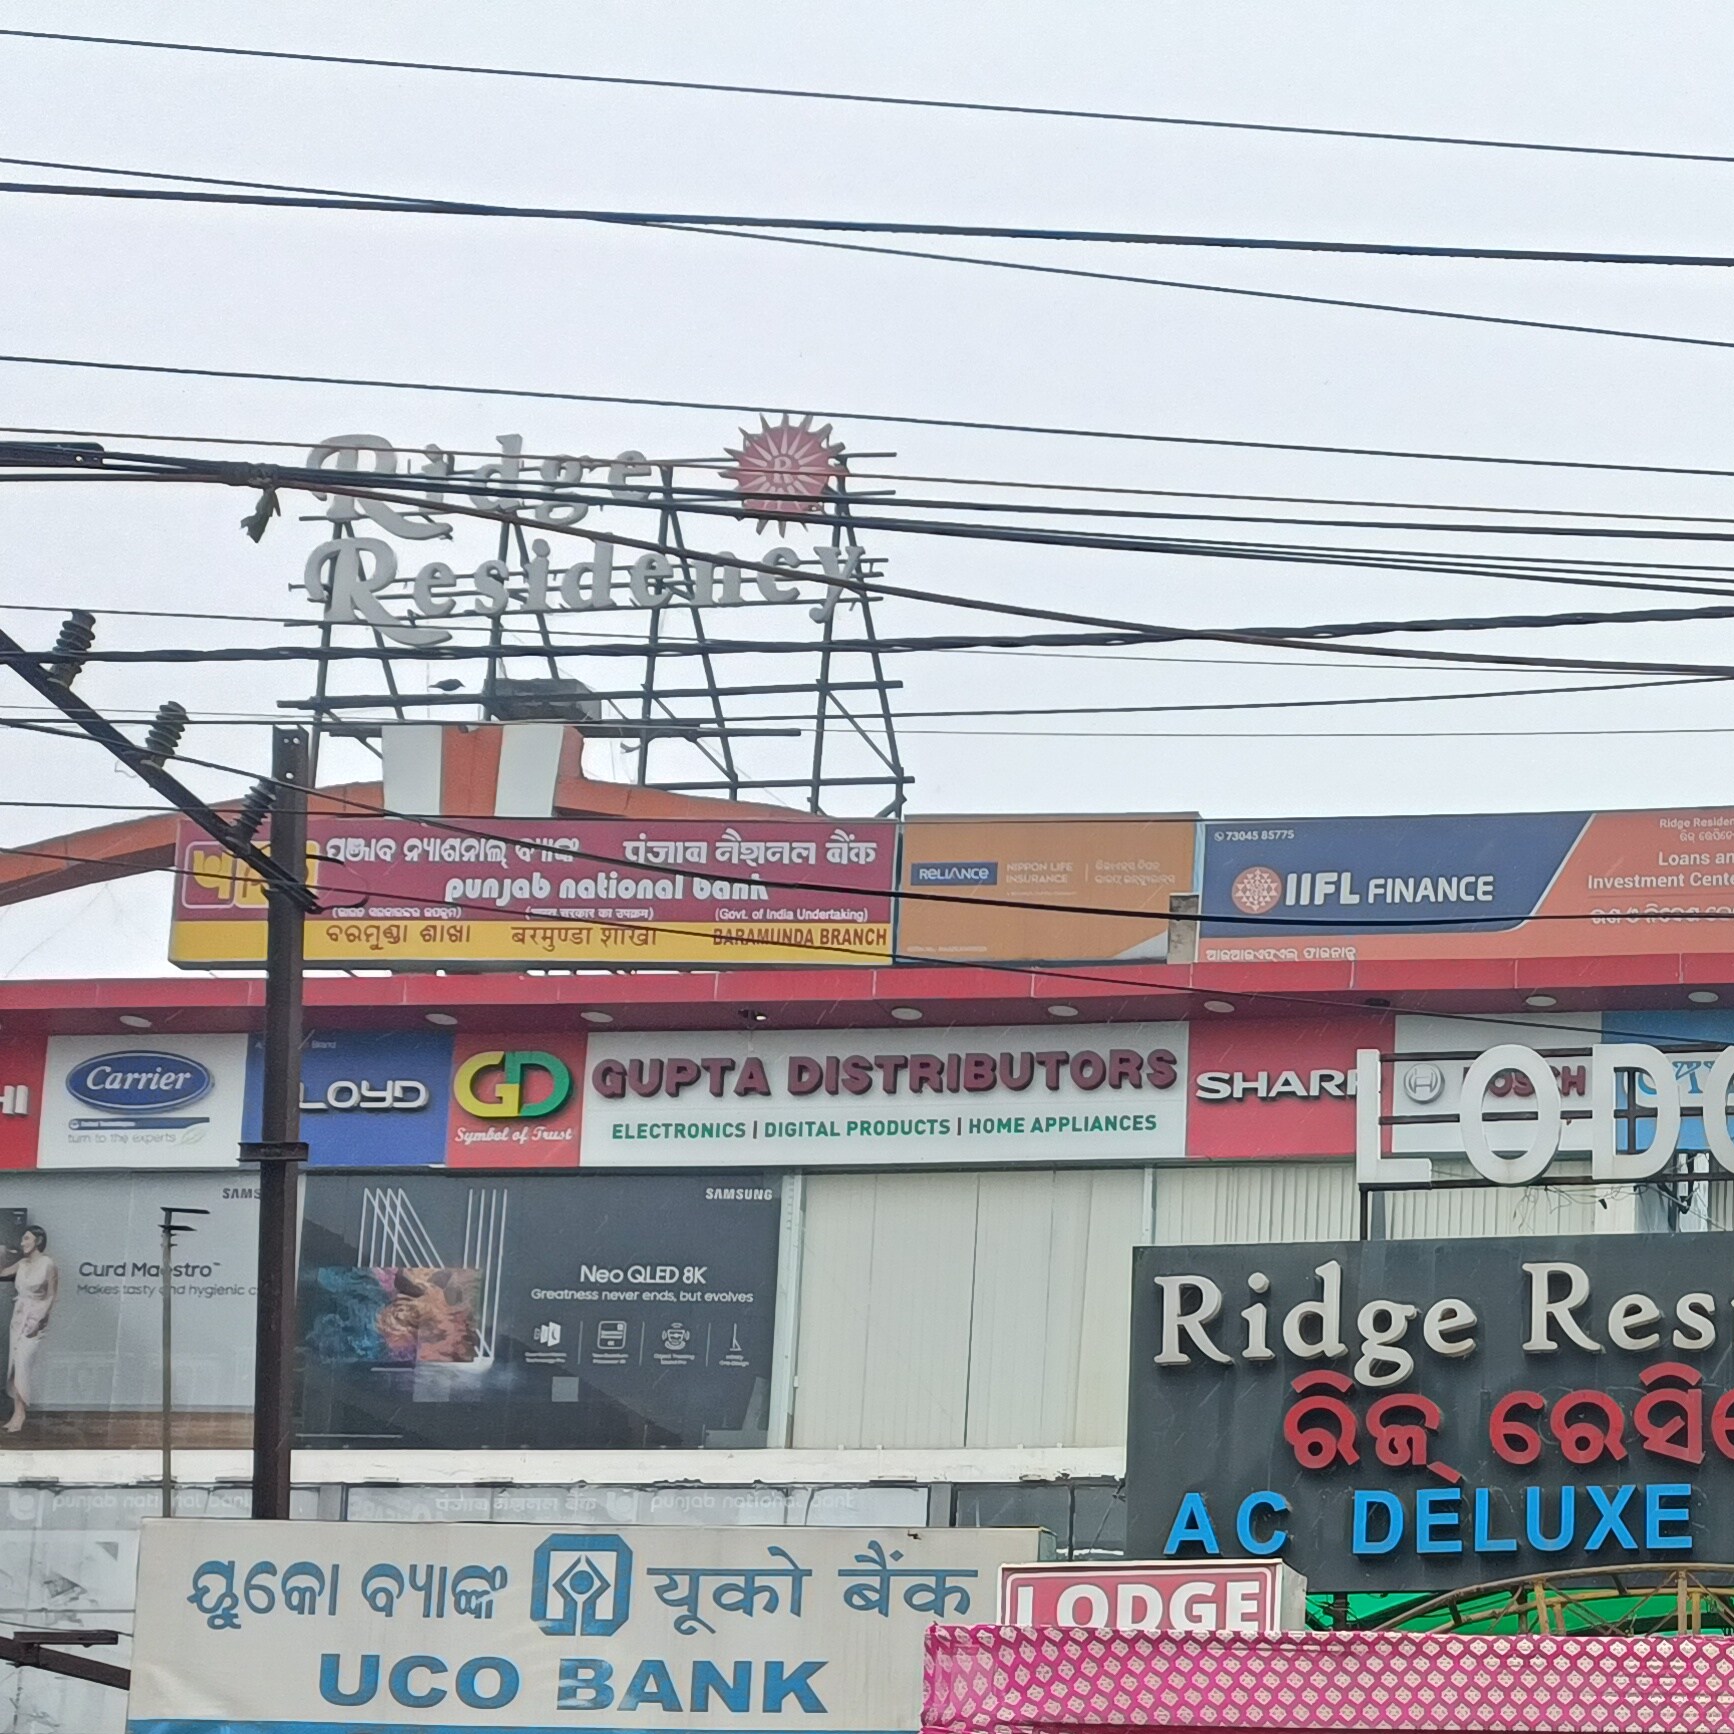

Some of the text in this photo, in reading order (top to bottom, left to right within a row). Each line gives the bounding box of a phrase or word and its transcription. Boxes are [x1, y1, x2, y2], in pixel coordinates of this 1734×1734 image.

[306, 434, 652, 541] Ridge
[304, 535, 866, 647] Residency
[1226, 829, 1295, 842] 73045 85775
[1659, 818, 1691, 830] Ridge
[623, 833, 708, 865] पंजाब
[825, 829, 878, 865] बैंक
[1658, 851, 1710, 866] Loans
[1006, 862, 1074, 873] NIPPON LIFE
[1006, 874, 1069, 884] INSURANCE
[445, 871, 769, 906] punjab national bank
[1285, 872, 1494, 906] IIFL FINANCE
[1588, 874, 1685, 890] Investment
[751, 908, 763, 919] of
[766, 908, 794, 920] India
[797, 908, 868, 922] Undertaking)
[419, 924, 471, 944] ଶାଖା
[713, 928, 888, 947] BARAMUNDA BRANCH
[87, 1065, 192, 1091] Carrier
[454, 1051, 571, 1118] GD
[592, 1048, 1179, 1100] GUPTA DISTRIBUTORS
[1463, 1064, 1587, 1098] OSH
[299, 1079, 430, 1110] LOYD
[132, 1132, 177, 1145] experts
[454, 1125, 573, 1143] Symbol of Trust
[612, 1114, 1158, 1140] ELECTRONICS DIGITAL PRODUCTS HOME APPLIANCES
[705, 1188, 773, 1201] SAMSUNG
[79, 1261, 127, 1278] Curd
[580, 1264, 708, 1285] Neo QLED 8K
[77, 1284, 119, 1296] Makes
[123, 1284, 155, 1299] tasty
[188, 1283, 245, 1299] hygienic
[531, 1288, 754, 1303] Greatness never ends, but evolves
[1154, 1261, 1477, 1387] Ridge
[1284, 1370, 1463, 1483] ରିଜ୍
[1163, 1491, 1288, 1557] AC
[1353, 1483, 1694, 1556] DELUXE
[646, 1540, 980, 1635] यूको बैंक
[319, 1653, 830, 1715] UCO BANK
